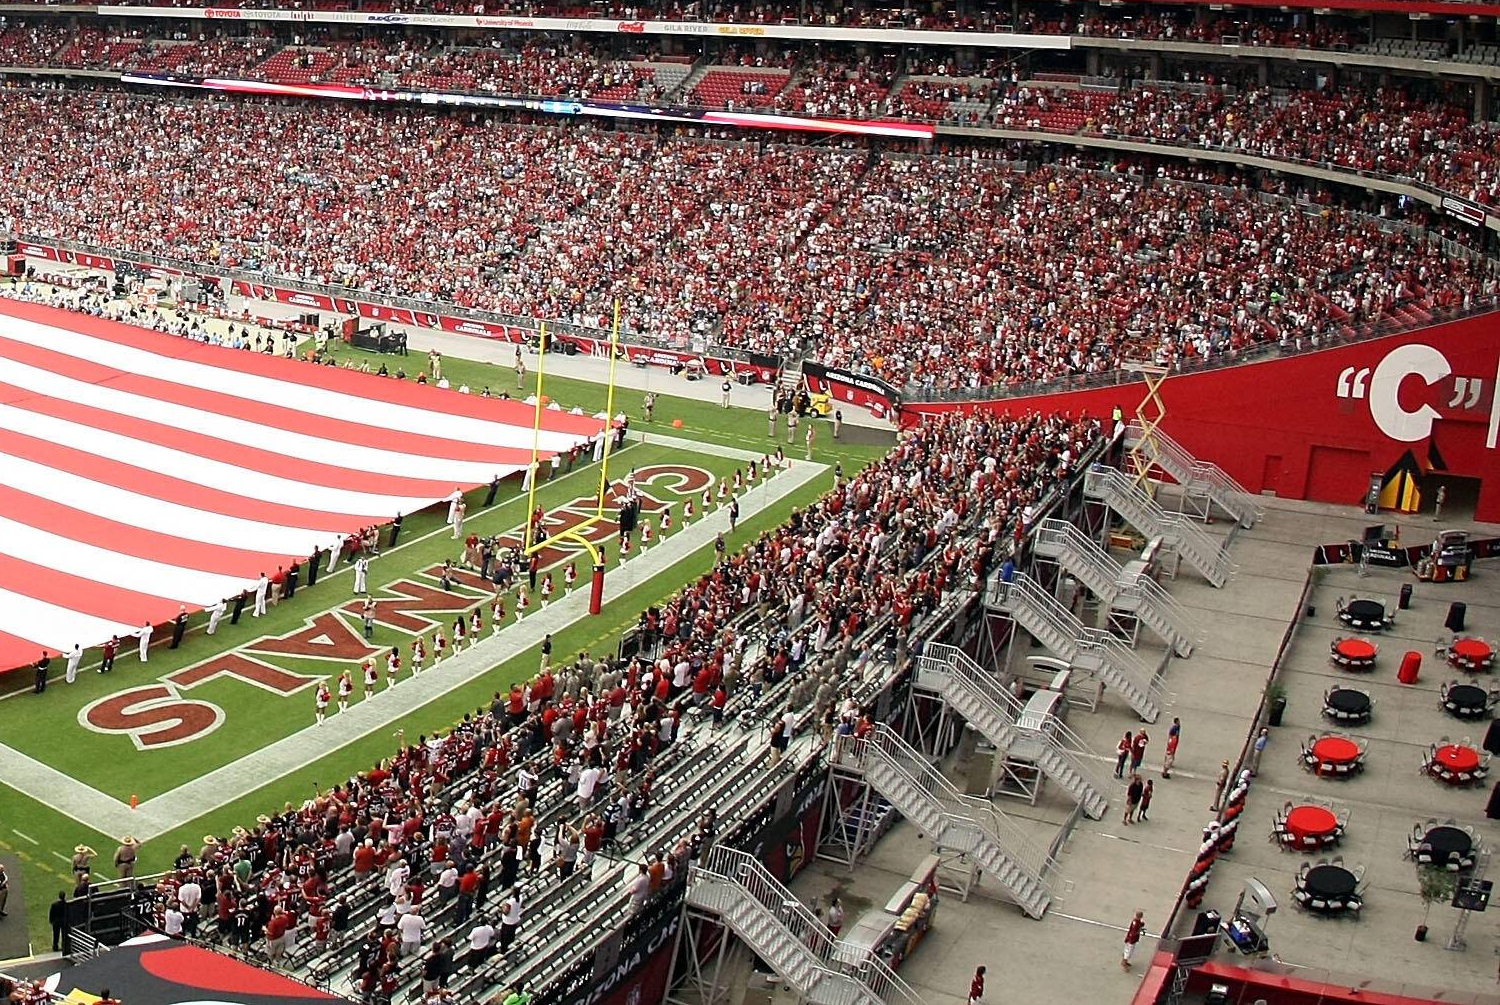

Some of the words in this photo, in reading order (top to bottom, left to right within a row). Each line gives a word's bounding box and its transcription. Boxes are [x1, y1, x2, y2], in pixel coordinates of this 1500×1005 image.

[254, 11, 281, 19] TOYOTA
[288, 297, 321, 307] CARDINALS
[455, 325, 492, 336] CARDINALS
[654, 352, 678, 360] ARIZONA
[825, 372, 854, 384] ARIZONA
[519, 776, 527, 789] 11
[250, 851, 256, 862] 11
[137, 903, 152, 915] 72
[237, 918, 245, 926] 11
